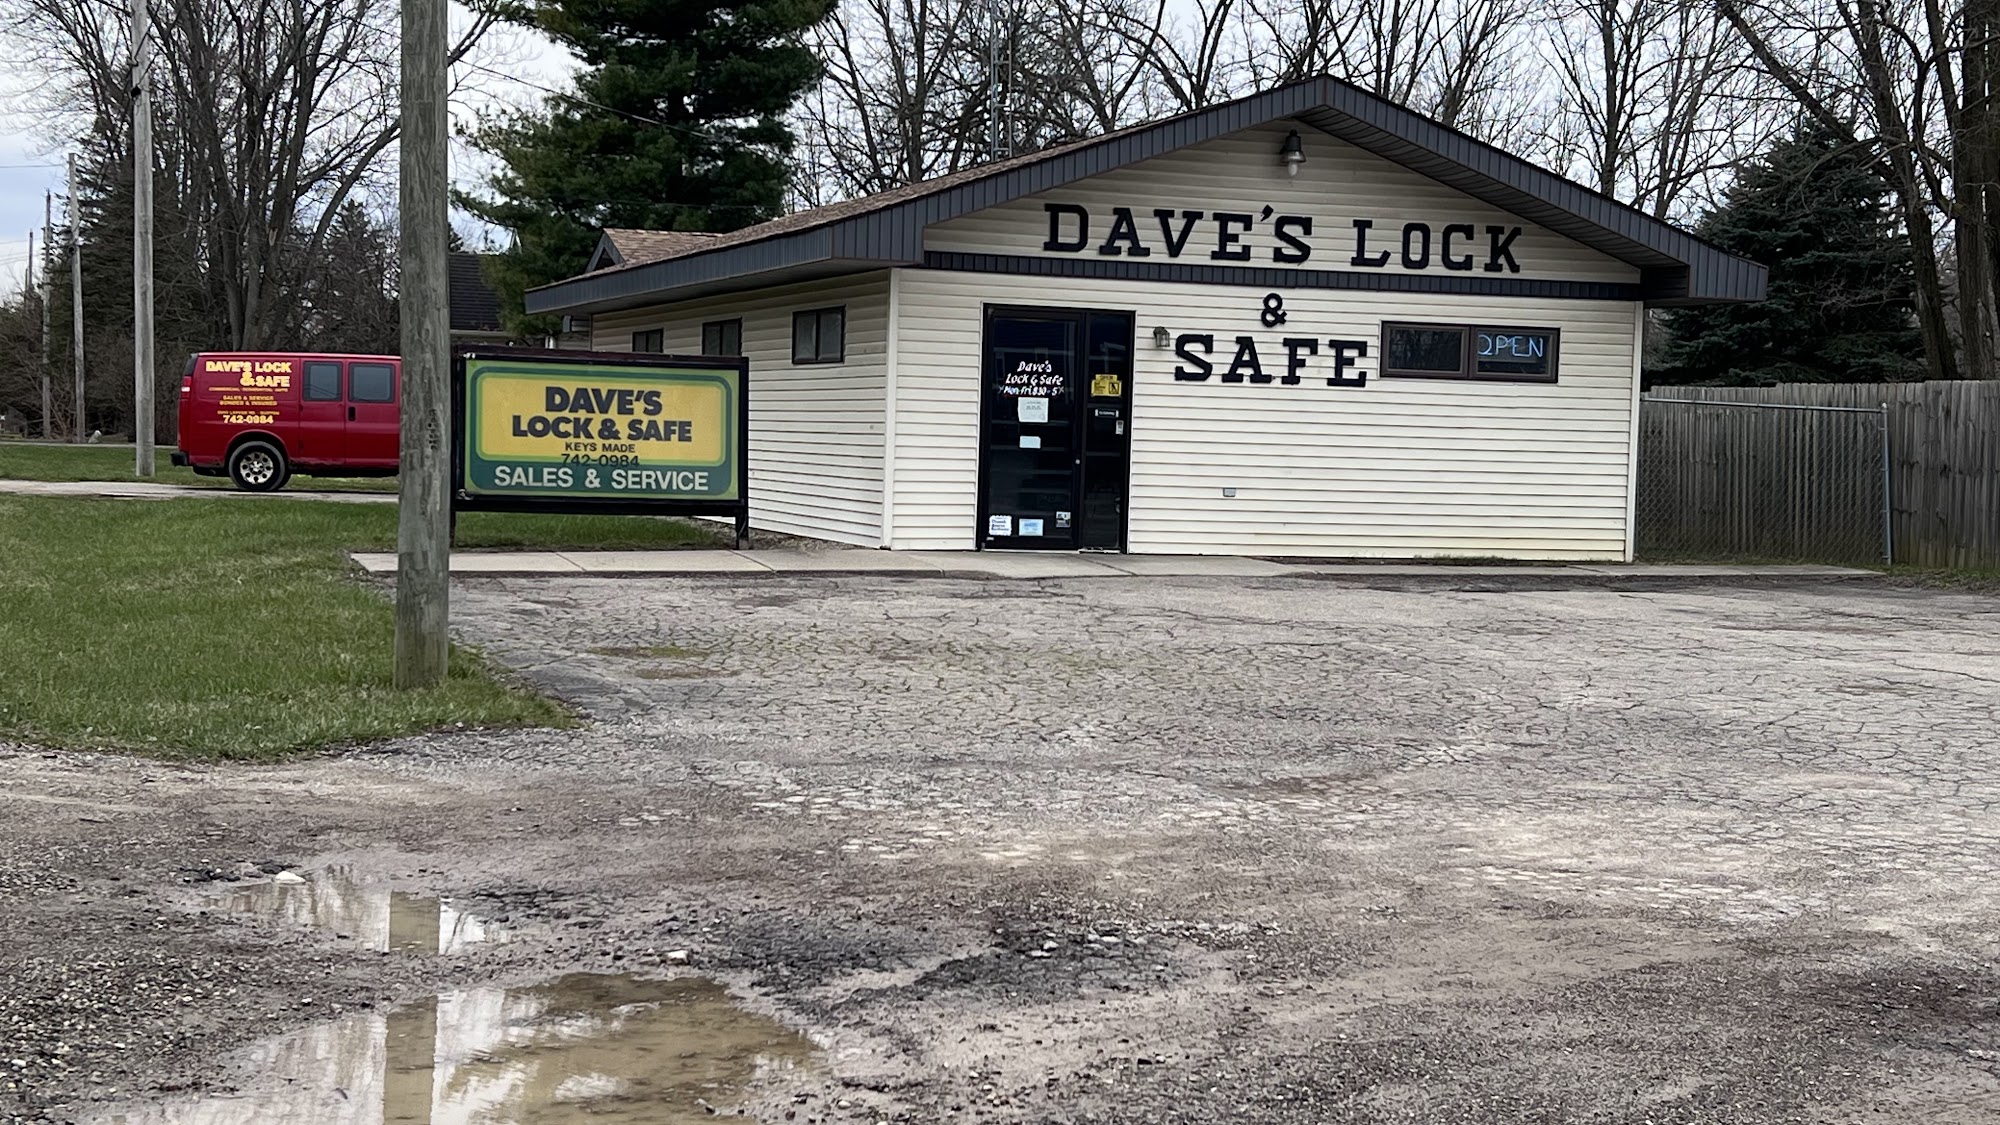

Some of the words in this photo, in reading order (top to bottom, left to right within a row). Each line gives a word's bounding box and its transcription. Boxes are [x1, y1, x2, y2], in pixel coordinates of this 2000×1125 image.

[1043, 203, 1312, 265] DAVE'S
[1351, 219, 1522, 272] LOCK
[1261, 293, 1287, 327] &
[1477, 334, 1544, 357] OPEN
[206, 361, 252, 372] DAVE'S
[255, 362, 292, 373] LOCK
[1017, 360, 1052, 372] Dave's
[1174, 333, 1368, 387] SAFE
[240, 371, 255, 386] &
[256, 376, 290, 387] SAFE
[1005, 373, 1029, 384] Lock
[1039, 374, 1063, 385] Safe
[545, 386, 663, 416] DAVE'S
[223, 415, 274, 424] 742-0984
[512, 415, 594, 439] LOCK
[598, 418, 621, 440] &
[627, 419, 692, 442] SAFE
[565, 442, 597, 452] KEYS
[602, 443, 636, 453] MADE
[561, 454, 640, 468] 742-0984
[494, 466, 573, 488] SALES
[585, 469, 600, 488] &
[611, 470, 709, 491] SERVICE
